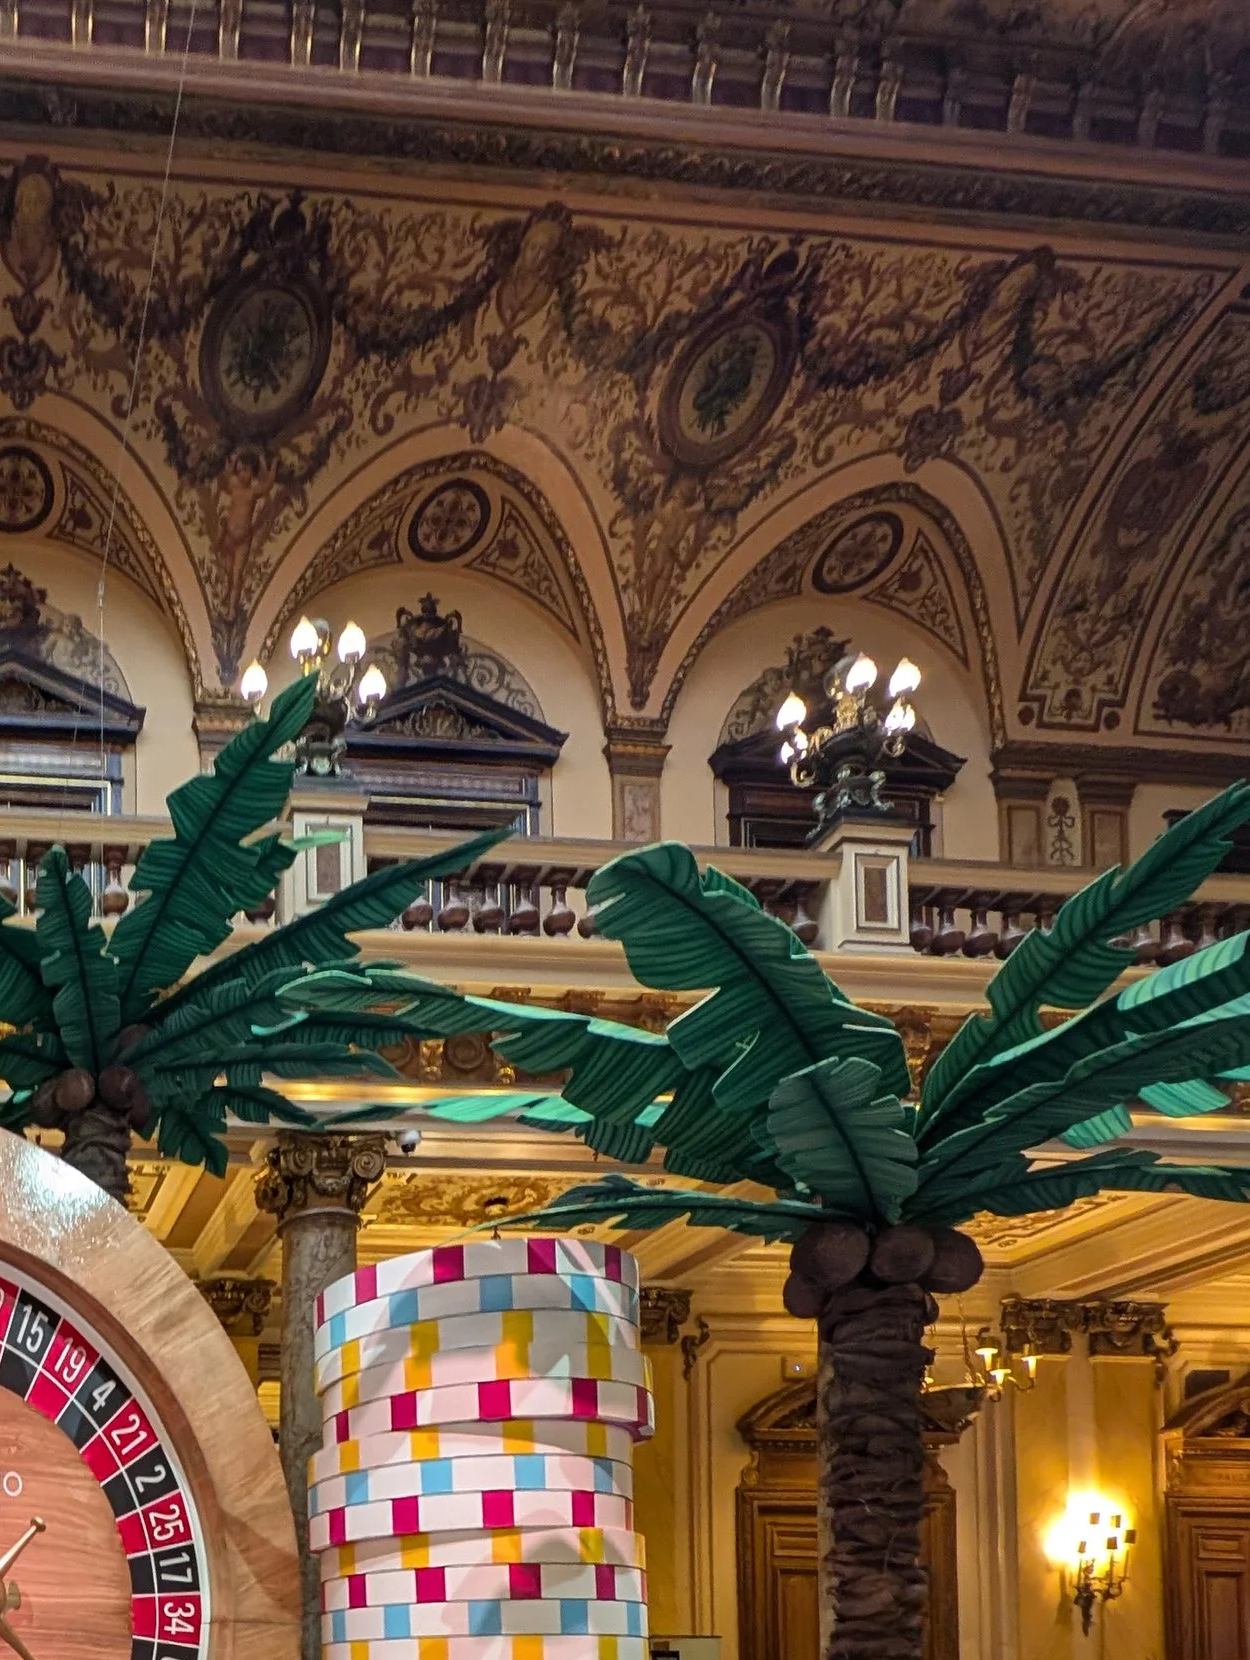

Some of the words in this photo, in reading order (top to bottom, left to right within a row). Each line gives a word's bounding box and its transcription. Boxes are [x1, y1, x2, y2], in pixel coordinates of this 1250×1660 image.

[16, 1303, 49, 1353] 15
[53, 1337, 87, 1384] 19
[91, 1379, 118, 1411] 4
[111, 1413, 148, 1456] 21
[135, 1464, 166, 1494] 2
[148, 1504, 184, 1542] 25
[159, 1552, 191, 1584] 17
[163, 1602, 195, 1635] 34
